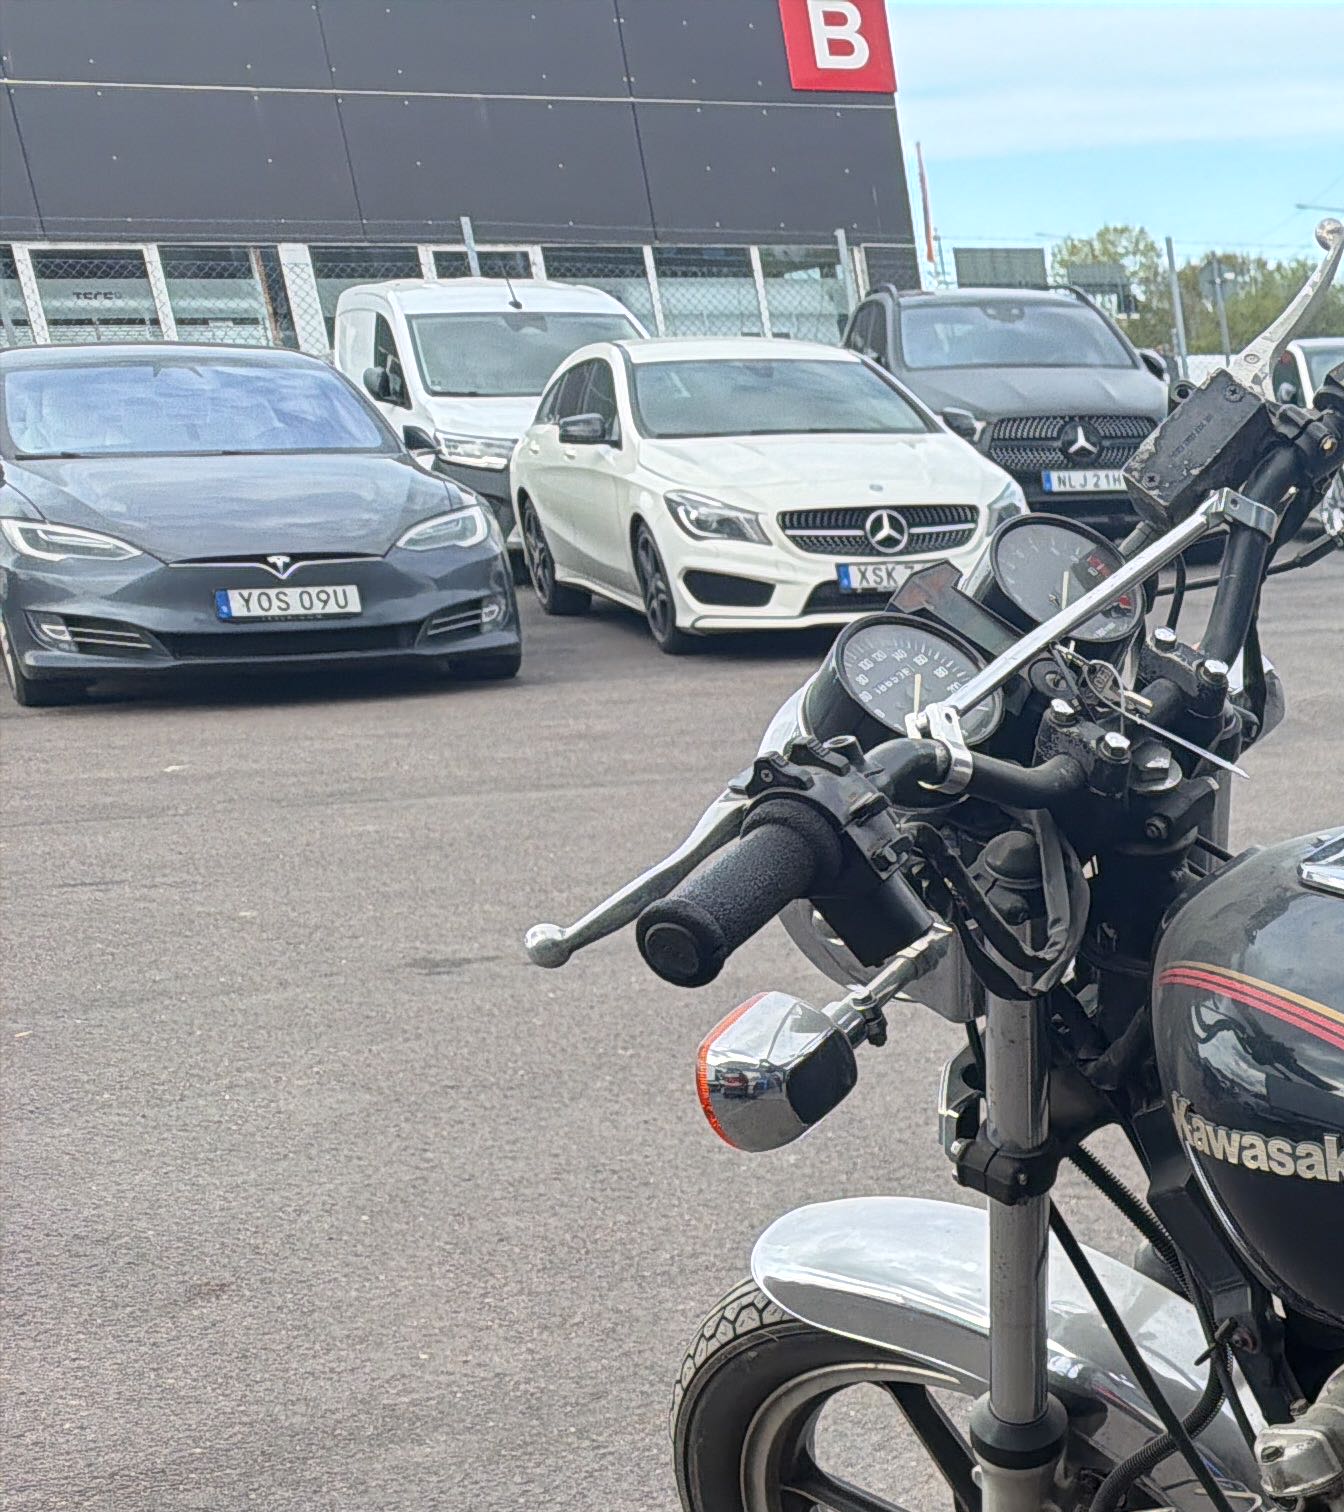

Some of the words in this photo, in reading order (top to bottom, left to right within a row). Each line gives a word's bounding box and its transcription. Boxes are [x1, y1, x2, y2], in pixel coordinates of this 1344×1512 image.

[806, 0, 869, 69] B
[1056, 473, 1088, 489] NLJ
[1092, 473, 1122, 488] 21H
[857, 565, 898, 586] XSK
[238, 591, 290, 613] YOS
[299, 588, 349, 610] 09U
